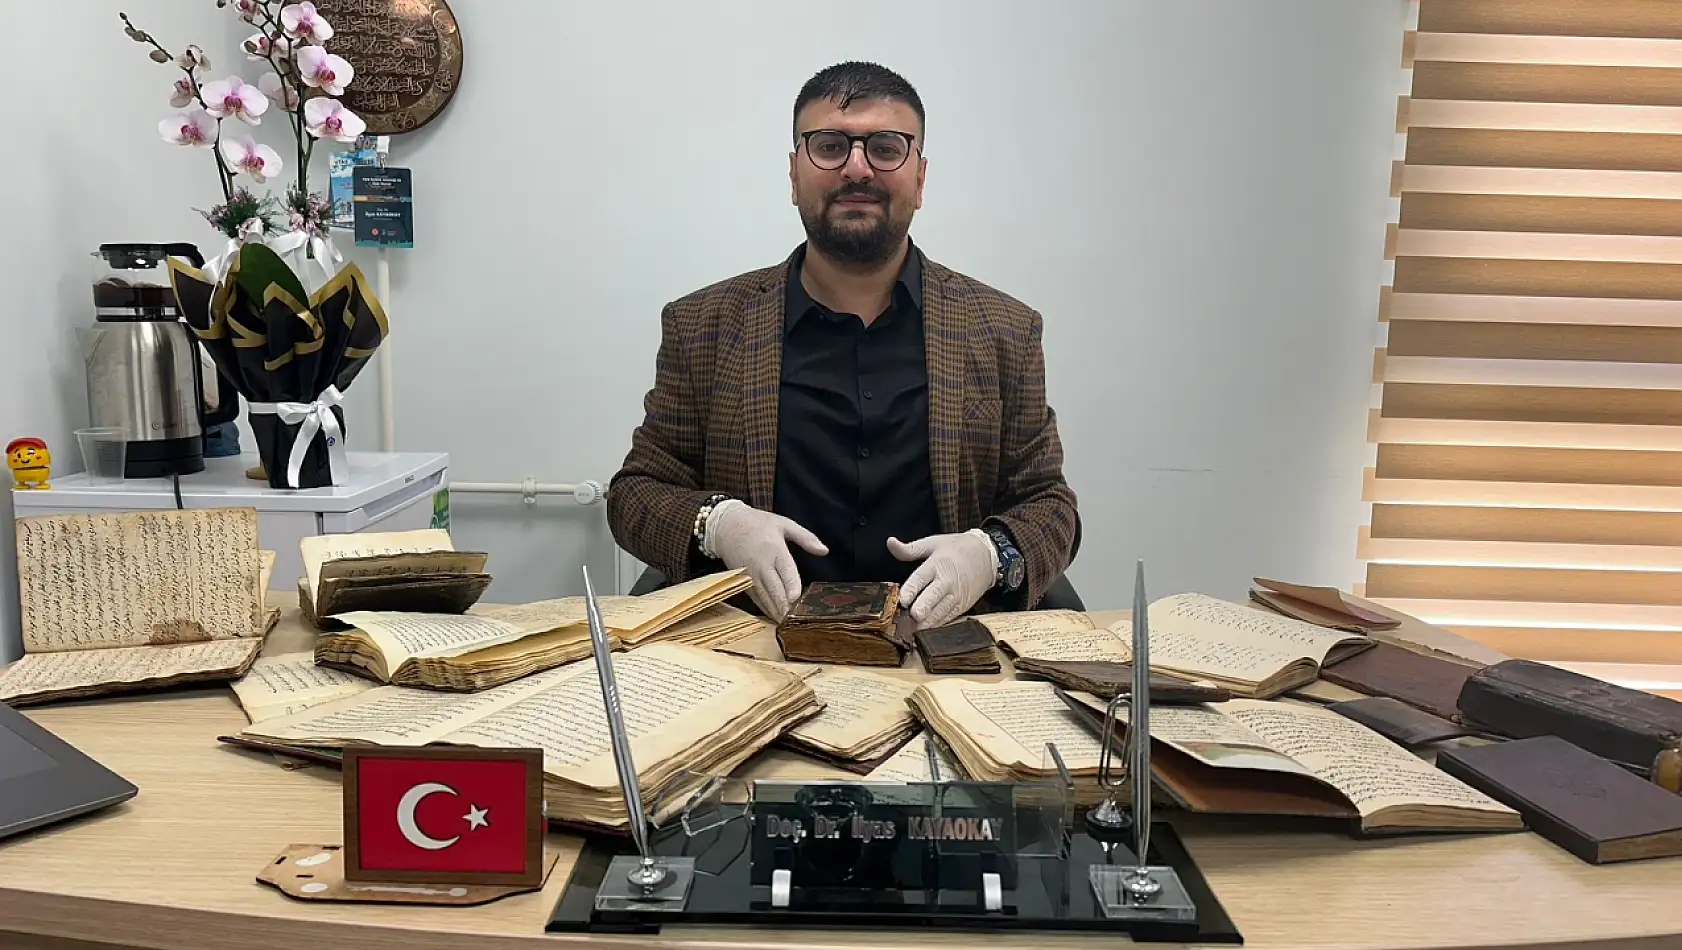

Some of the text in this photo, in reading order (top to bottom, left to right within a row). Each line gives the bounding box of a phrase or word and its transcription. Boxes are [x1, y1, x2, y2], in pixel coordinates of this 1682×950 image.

[767, 814, 806, 843] Doç.
[814, 814, 840, 839] Dr.
[908, 816, 1004, 841] KAYAOKAY
